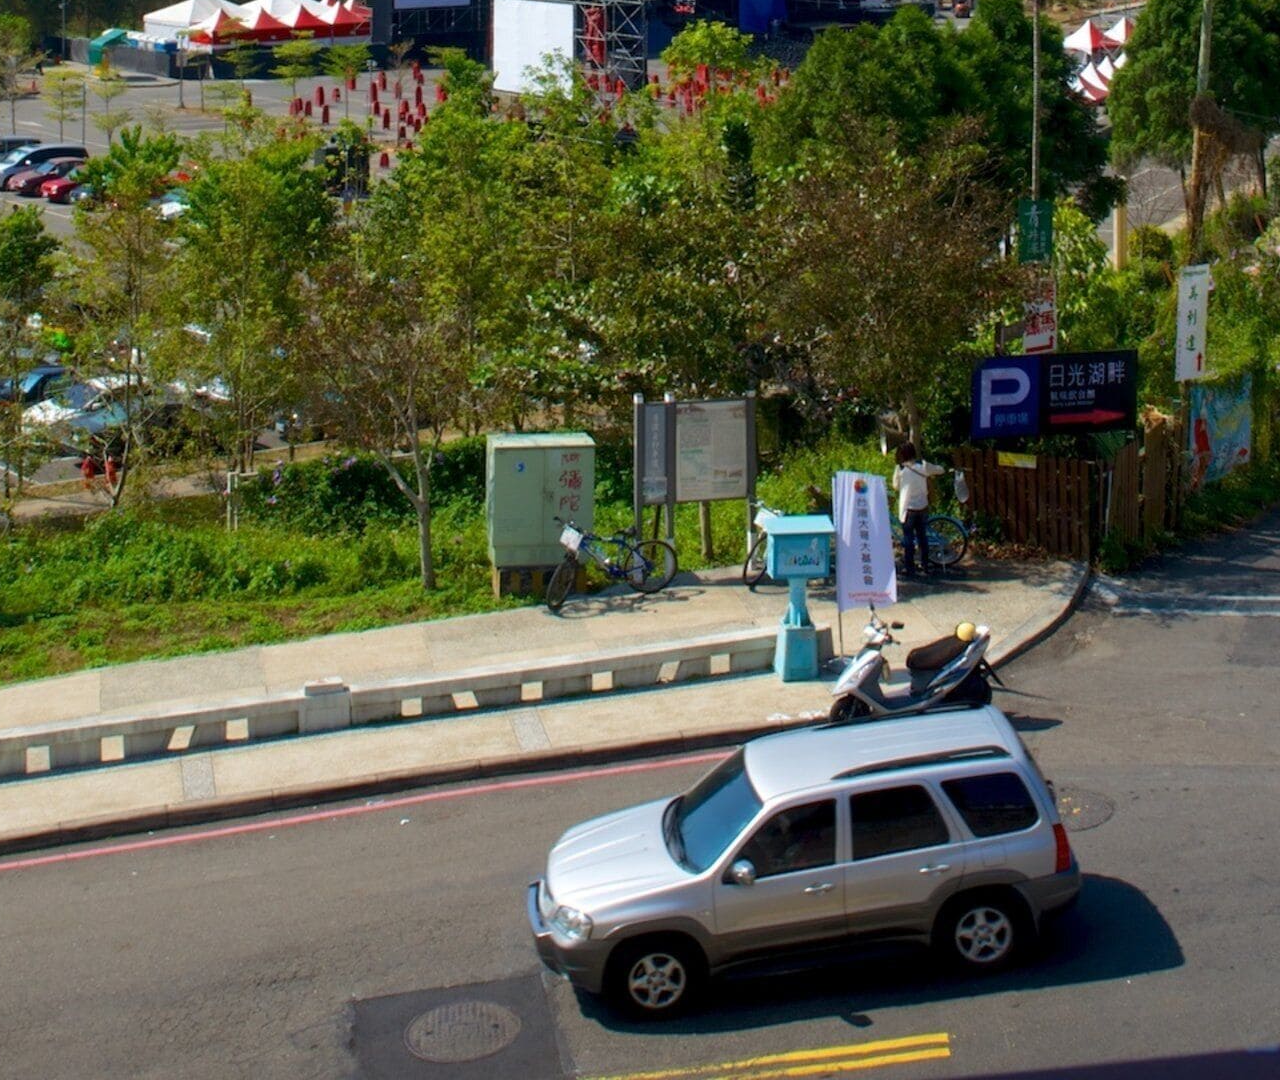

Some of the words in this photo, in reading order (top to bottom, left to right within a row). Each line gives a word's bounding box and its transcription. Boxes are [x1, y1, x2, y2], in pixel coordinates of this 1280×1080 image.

[980, 367, 1031, 429] P
[1049, 360, 1126, 387] 日光湖畔
[856, 498, 874, 586] 台灣大哥大基金會
